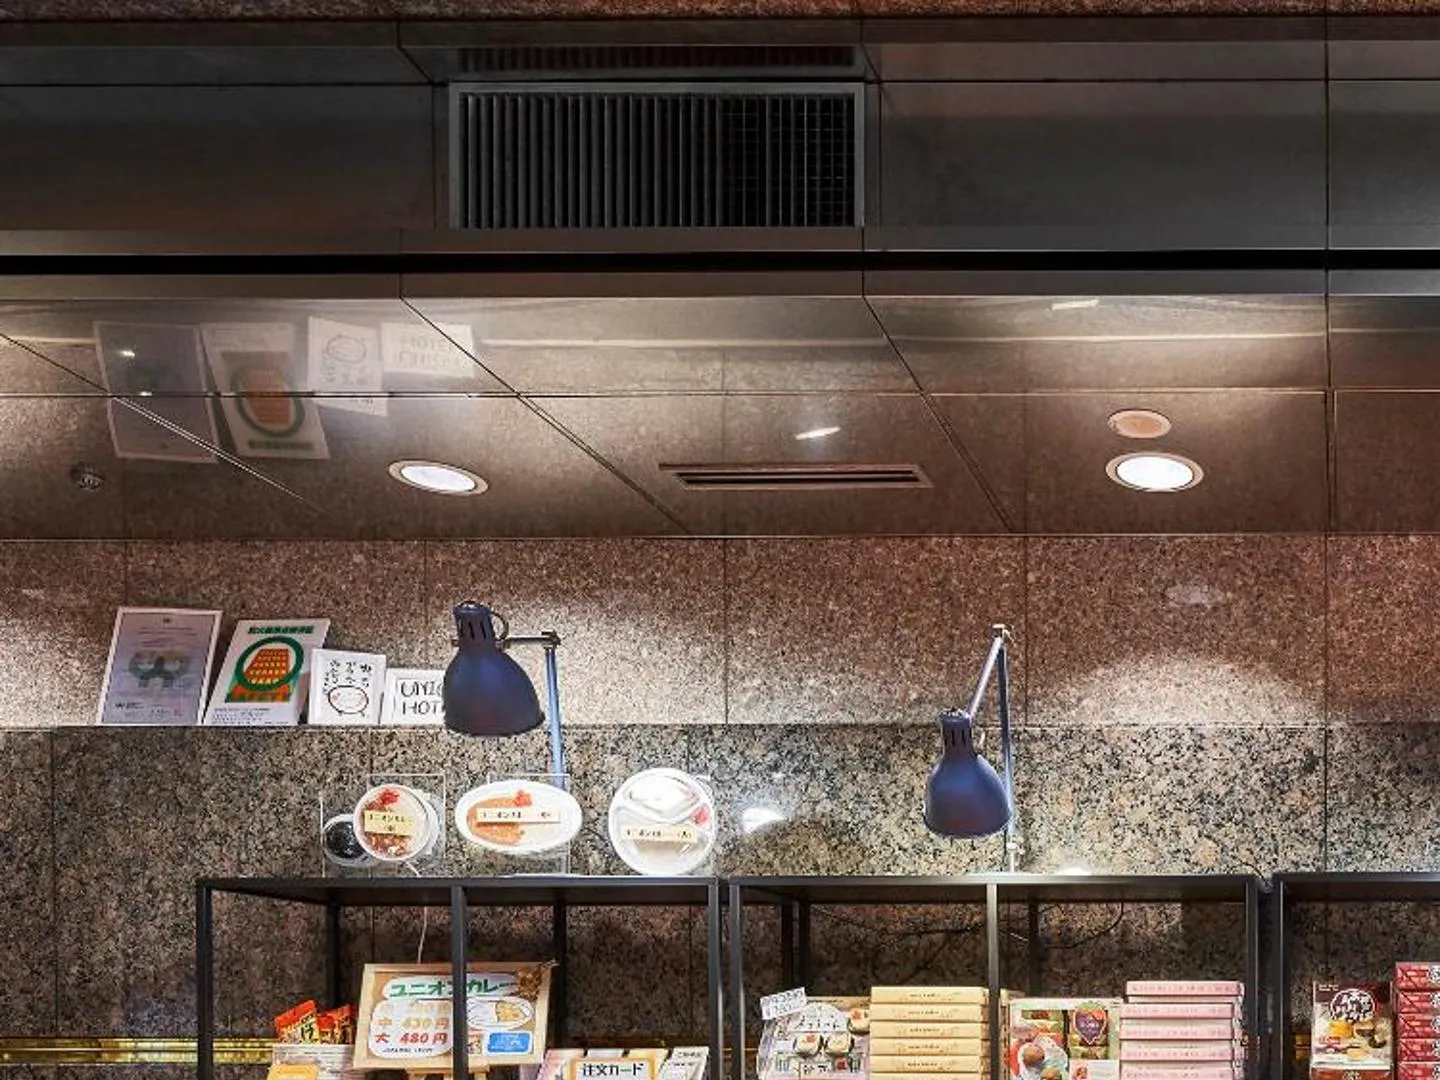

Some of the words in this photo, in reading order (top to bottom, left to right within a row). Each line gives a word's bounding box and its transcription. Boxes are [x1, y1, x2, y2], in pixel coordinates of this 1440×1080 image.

[389, 978, 516, 997] ユニオカレー
[582, 1062, 645, 1077] 注文カード
